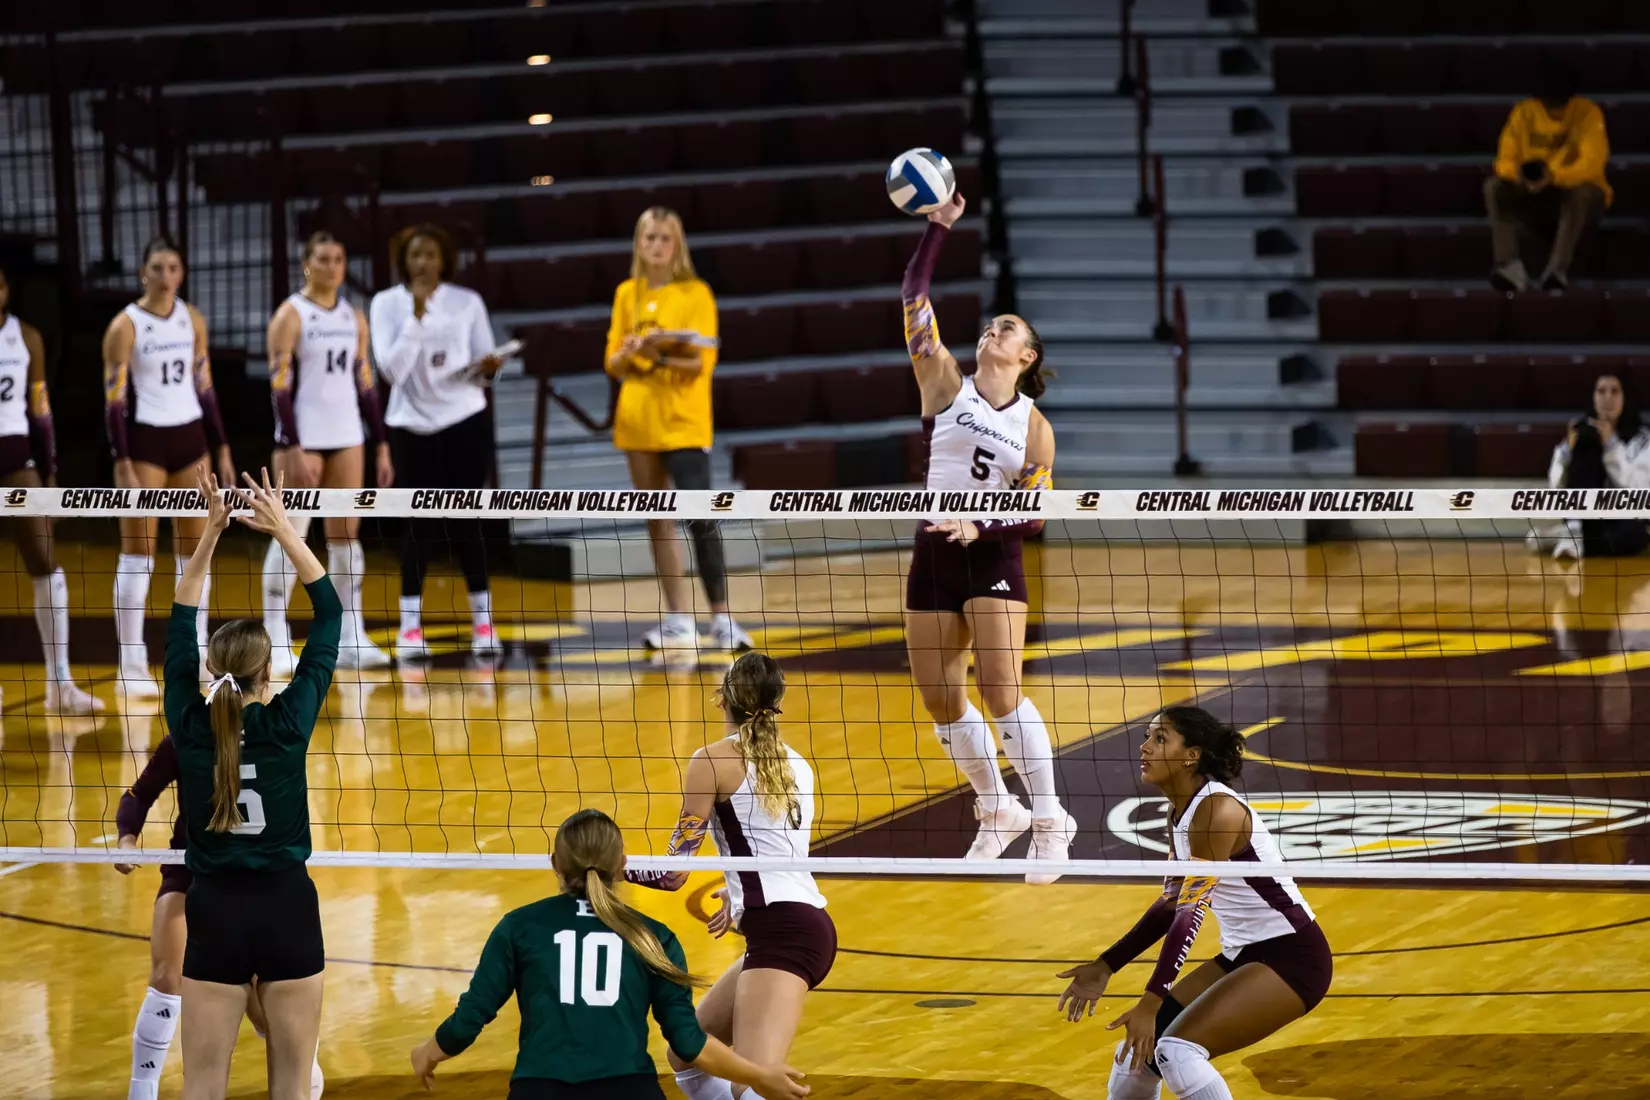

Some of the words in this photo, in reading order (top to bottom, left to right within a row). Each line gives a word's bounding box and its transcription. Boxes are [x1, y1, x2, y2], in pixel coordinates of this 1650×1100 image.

[161, 359, 185, 385] 13
[327, 349, 347, 373] 14
[956, 412, 1024, 452] Chippewas
[970, 445, 996, 481] 5
[61, 490, 131, 509] CENTRAL
[137, 490, 209, 509] MICHIGA
[411, 490, 483, 510] CENTRAL
[489, 490, 574, 511] MICHIGAN
[576, 491, 677, 512] VOLLEYBALL
[770, 491, 843, 512] CENTRAL
[848, 491, 935, 512] MICHIGAN
[939, 491, 1042, 512] VOLLEYBALL
[1136, 491, 1211, 512] CENTRAL
[1217, 490, 1306, 512] MICHIGAN
[1308, 490, 1414, 512] VOLLEYBALL
[1511, 490, 1588, 511] CENTRAL
[553, 929, 623, 1007] 10
